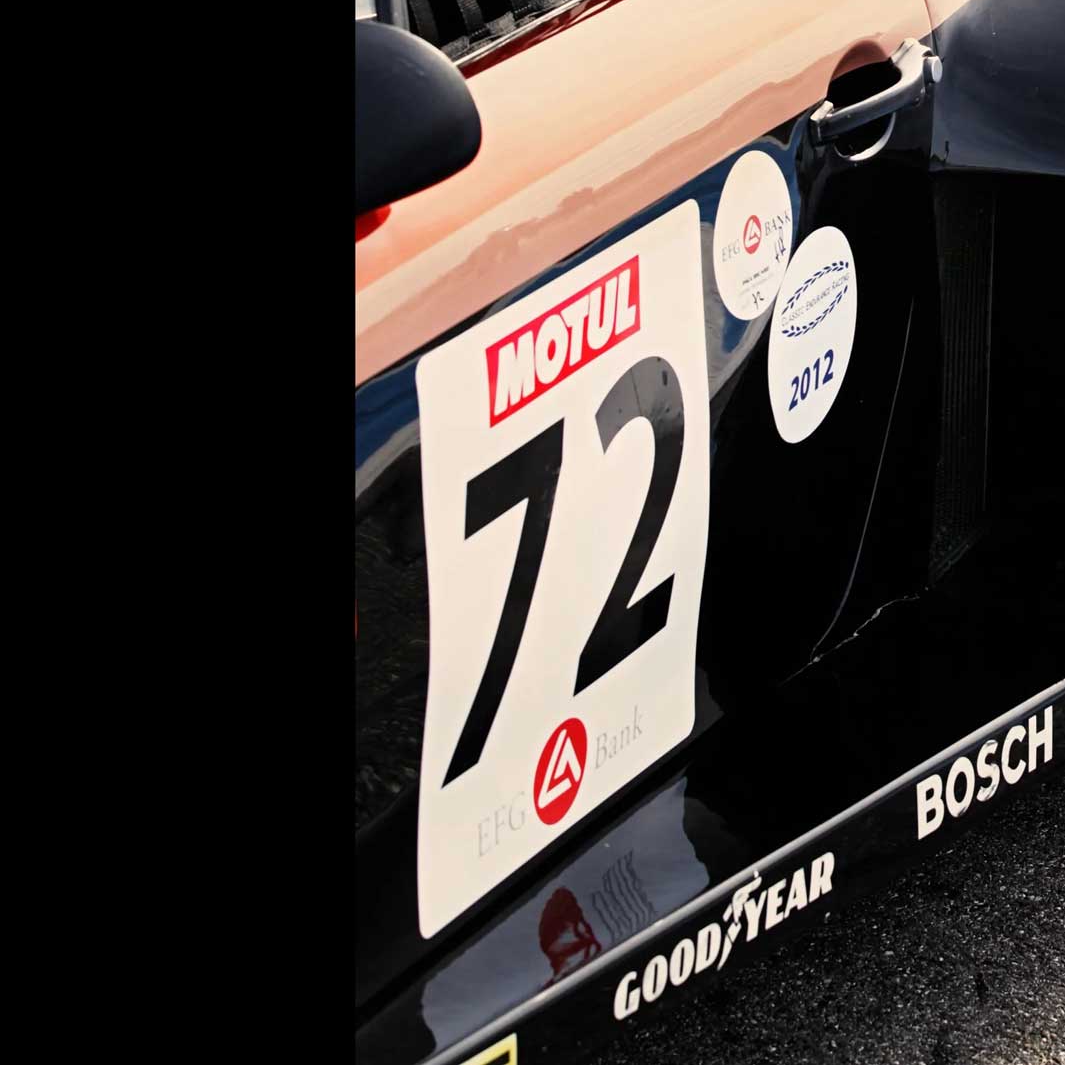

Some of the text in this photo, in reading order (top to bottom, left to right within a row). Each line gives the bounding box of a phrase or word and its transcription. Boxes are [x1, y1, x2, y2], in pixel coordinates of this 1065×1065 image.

[764, 209, 791, 236] BANK
[493, 268, 638, 417] MOTUL
[788, 348, 834, 412] 2012
[441, 355, 685, 790] 72
[478, 704, 644, 857] EFG Bank
[916, 704, 1054, 841] BOSCH
[613, 851, 835, 1021] GOODYEAR
